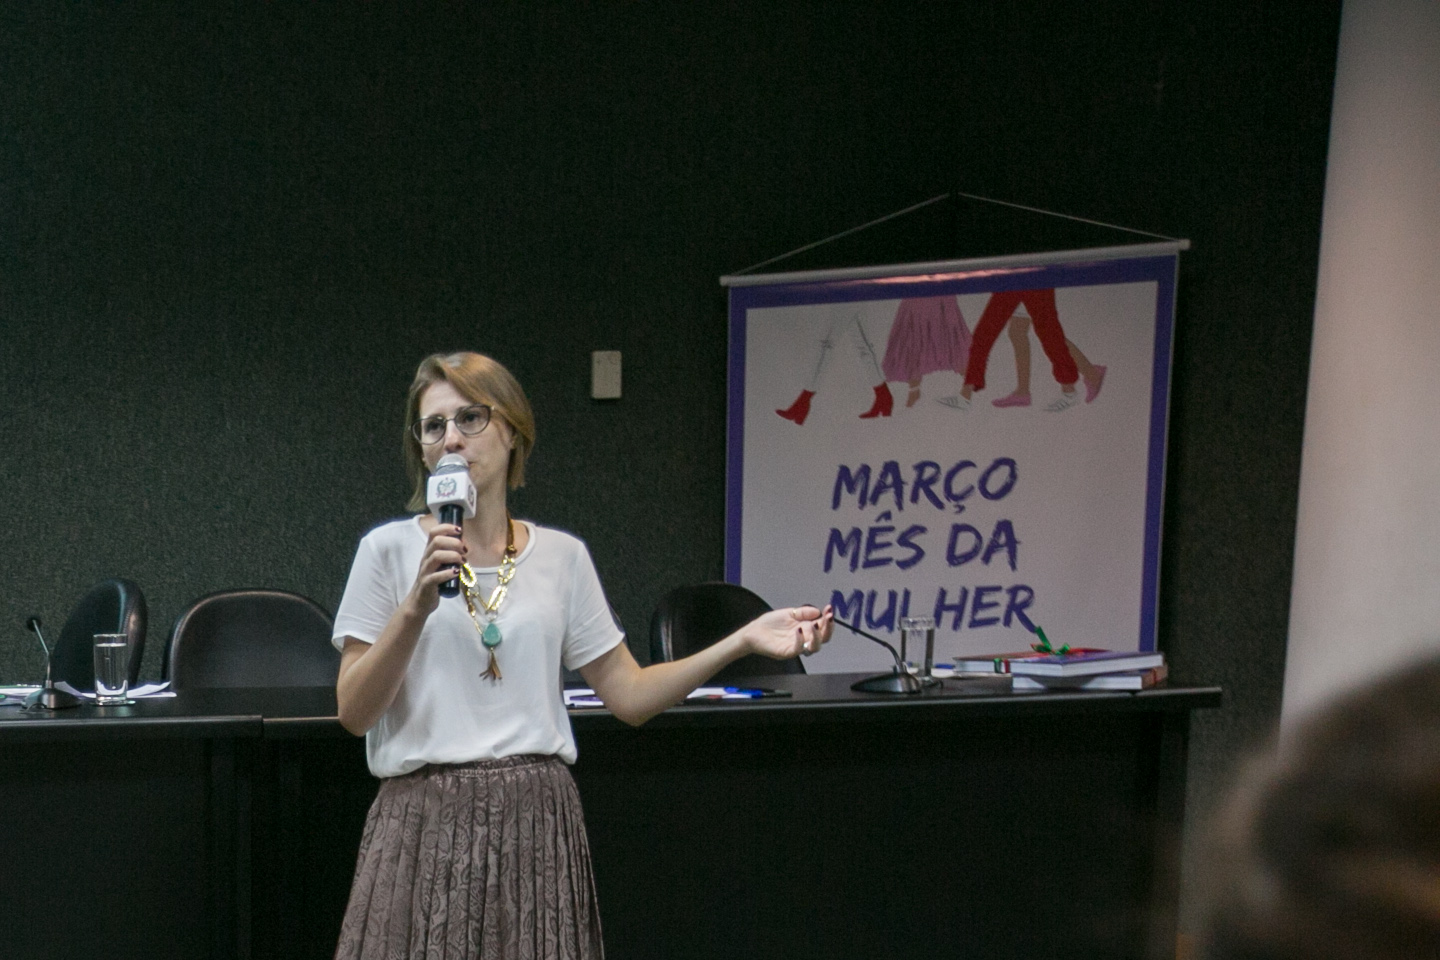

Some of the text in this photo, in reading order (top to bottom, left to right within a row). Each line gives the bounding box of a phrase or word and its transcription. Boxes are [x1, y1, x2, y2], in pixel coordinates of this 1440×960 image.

[831, 457, 1018, 514] MARÇO
[823, 510, 1022, 573] MÊS DA
